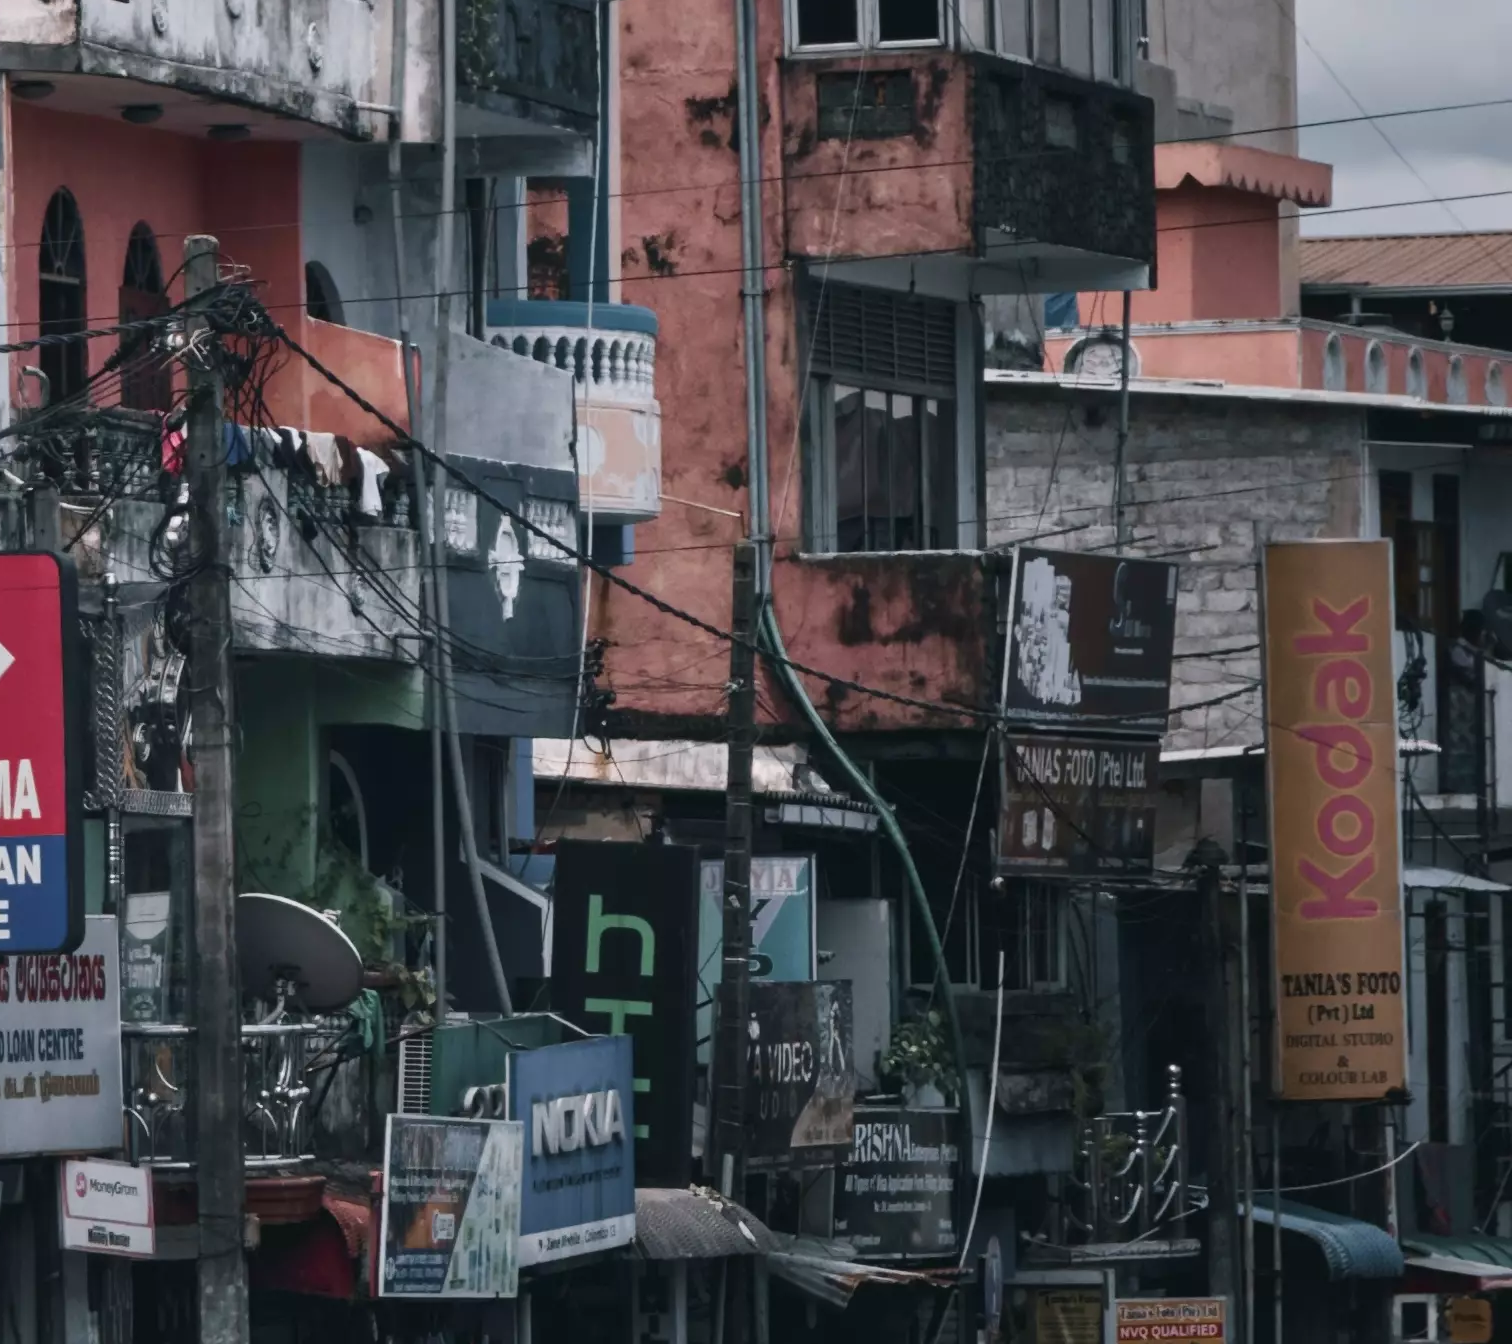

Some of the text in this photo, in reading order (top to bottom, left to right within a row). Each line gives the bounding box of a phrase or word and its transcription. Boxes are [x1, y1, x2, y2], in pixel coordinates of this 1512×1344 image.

[1292, 596, 1378, 919] Kodak
[1281, 972, 1401, 997] TANIA'S FOTO
[1308, 1003, 1374, 1026] (Pvt) Ltd
[8, 1029, 35, 1062] LOAN
[38, 1028, 83, 1061] CENTRE
[1285, 1032, 1393, 1048] DIGITAL STUDIO
[768, 1041, 813, 1083] VIDEO
[1337, 1055, 1349, 1068] &
[1299, 1071, 1388, 1085] COLOUR LAB
[533, 1089, 626, 1157] NOKIA
[849, 1123, 912, 1163] RISHNA
[89, 1178, 138, 1197] MoneyGram
[1120, 1323, 1218, 1340] NVQ QUALIFIED
